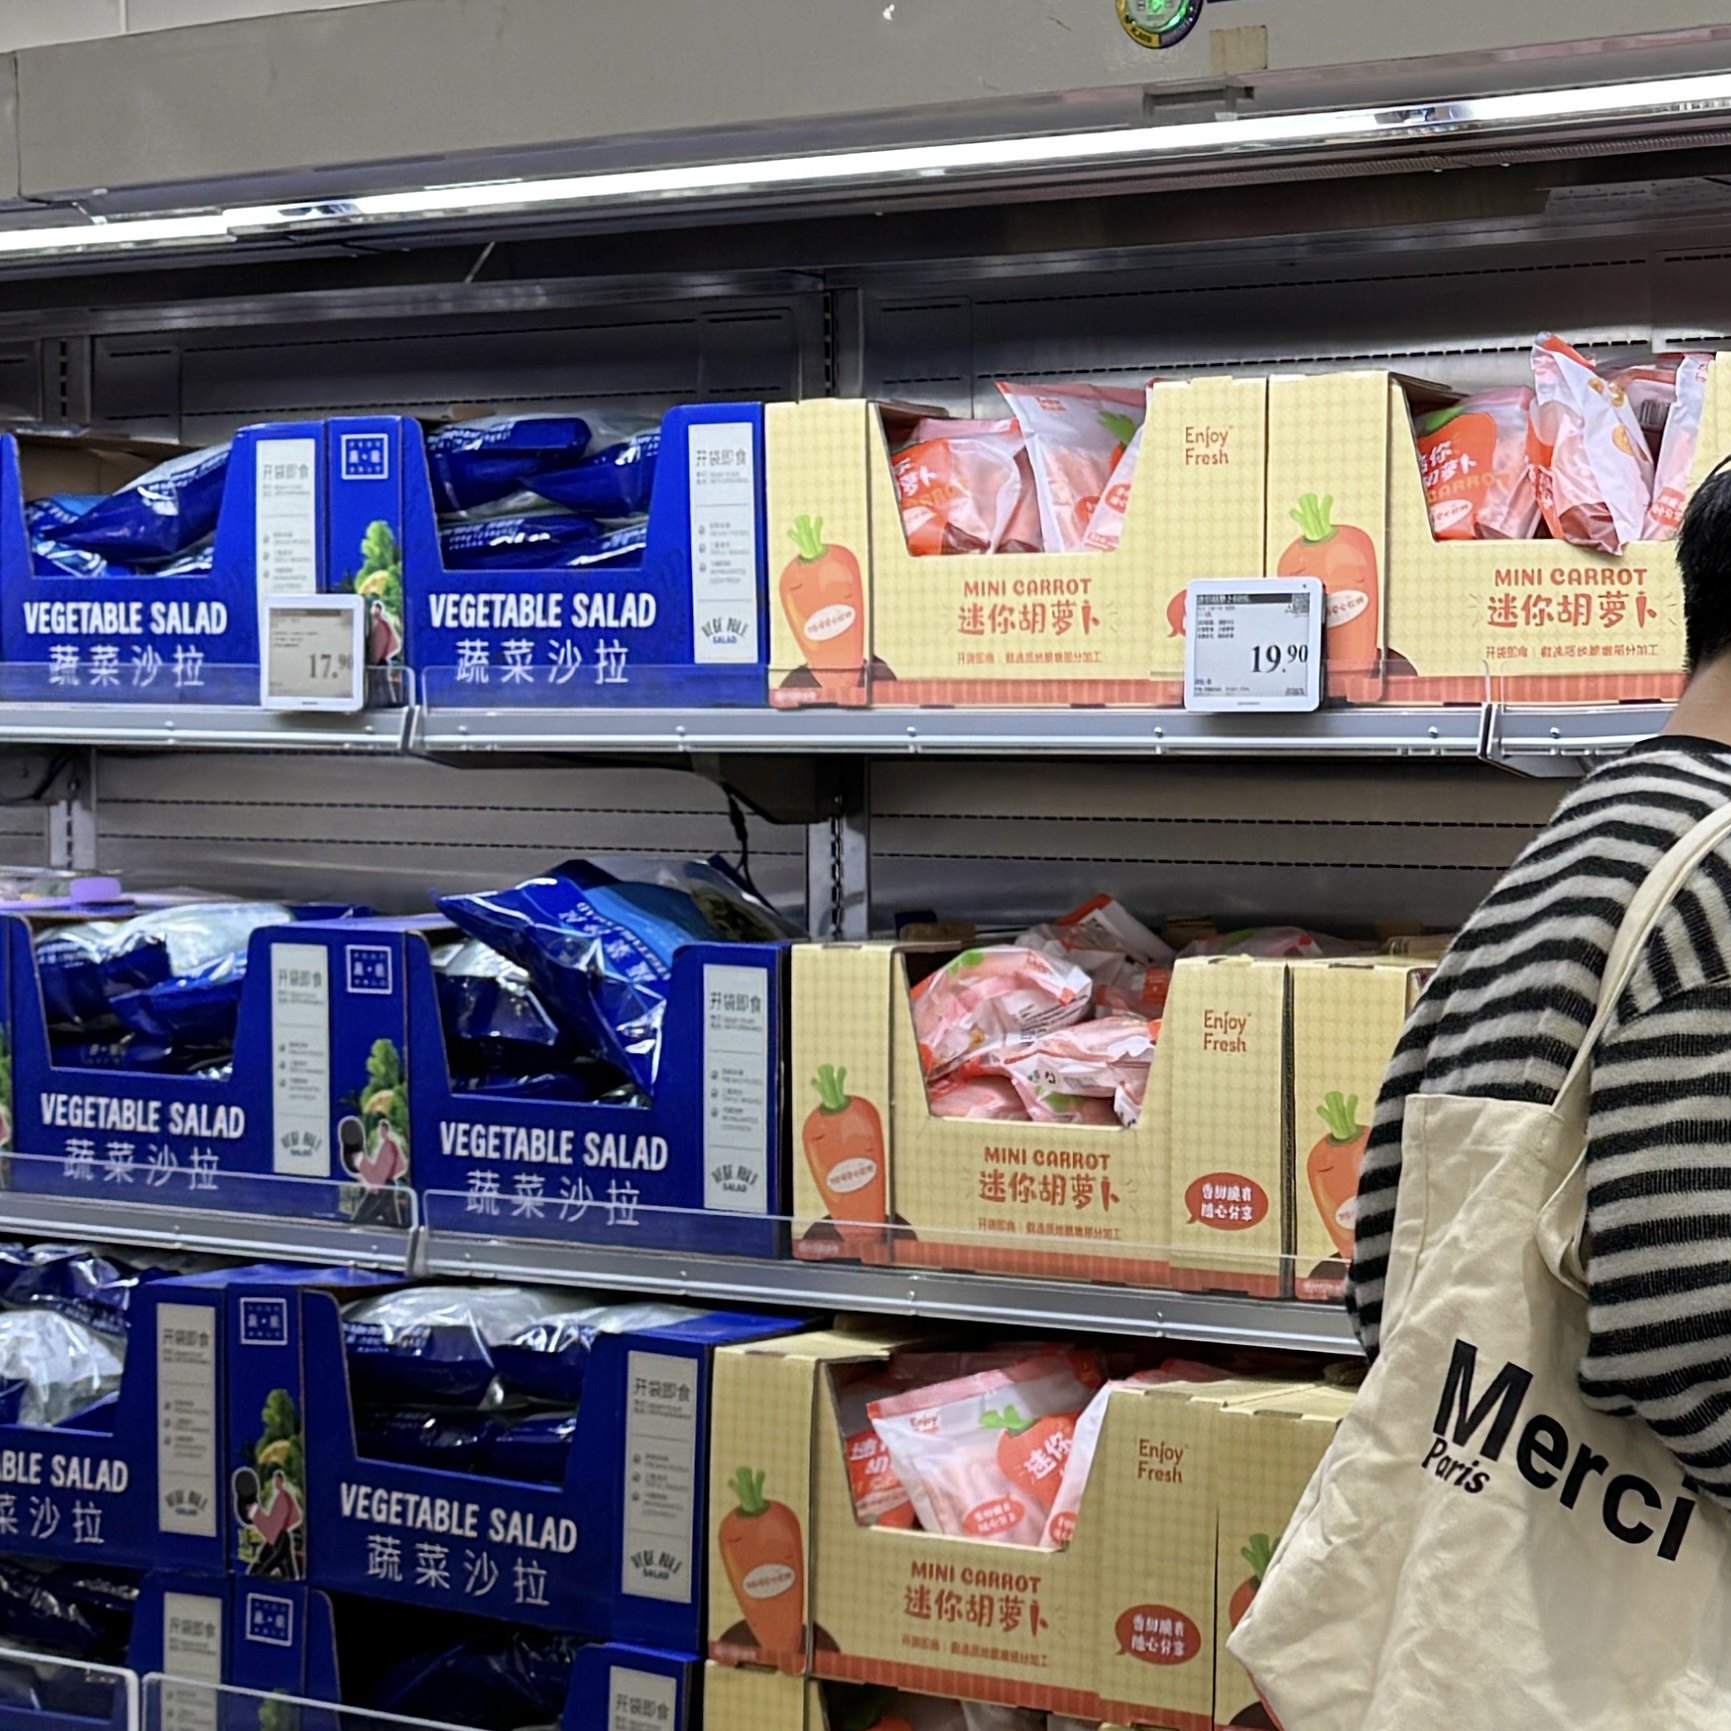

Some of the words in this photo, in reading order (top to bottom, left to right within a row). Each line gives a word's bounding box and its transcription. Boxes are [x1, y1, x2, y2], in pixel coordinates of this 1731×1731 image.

[1185, 426, 1229, 447] Enjoy
[1185, 448, 1229, 466] Fresh
[963, 579, 1006, 595] MINI
[1013, 577, 1092, 595] CARROT
[1494, 568, 1542, 587] MINI
[1550, 568, 1648, 586] CARROT
[23, 601, 143, 635] VEGETABLE
[150, 601, 228, 635] SALAD
[429, 593, 562, 627] VEGETABLE
[571, 592, 656, 628] SALAD
[957, 600, 1101, 637] 迷你胡萝卜
[1487, 590, 1657, 628] 迷你胡萝卜
[48, 644, 204, 687] 蔬菜沙拉
[455, 638, 629, 684] 蔬菜沙拉
[1251, 644, 1309, 673] 19.90
[1203, 1009, 1247, 1035] Enjoy
[1203, 1034, 1247, 1053] Fresh
[40, 1092, 161, 1133] VEGETABLE
[168, 1101, 245, 1139] SALAD
[63, 1138, 219, 1190] 蔬菜沙拉
[440, 1121, 574, 1165] VEGETABLE
[583, 1132, 668, 1172] SALAD
[984, 1145, 1027, 1165] MINI
[1033, 1148, 1111, 1171] CARROT
[465, 1168, 640, 1227] 蔬菜沙拉
[978, 1171, 1119, 1212] 迷你胡萝卜
[1138, 1438, 1185, 1465] Enjoy
[1421, 1437, 1491, 1494] Paris
[1433, 1338, 1698, 1561] Merci
[0, 1449, 43, 1485] BLE
[50, 1454, 128, 1493] SALAD
[1137, 1461, 1182, 1485] Fresh
[340, 1483, 479, 1539] VEGETABLE
[489, 1507, 577, 1554] SALAD
[367, 1534, 550, 1607] 蔬菜沙拉
[911, 1561, 955, 1582] MINI
[962, 1567, 1041, 1594] CARROT
[904, 1587, 1048, 1637] 迷你胡萝卜
